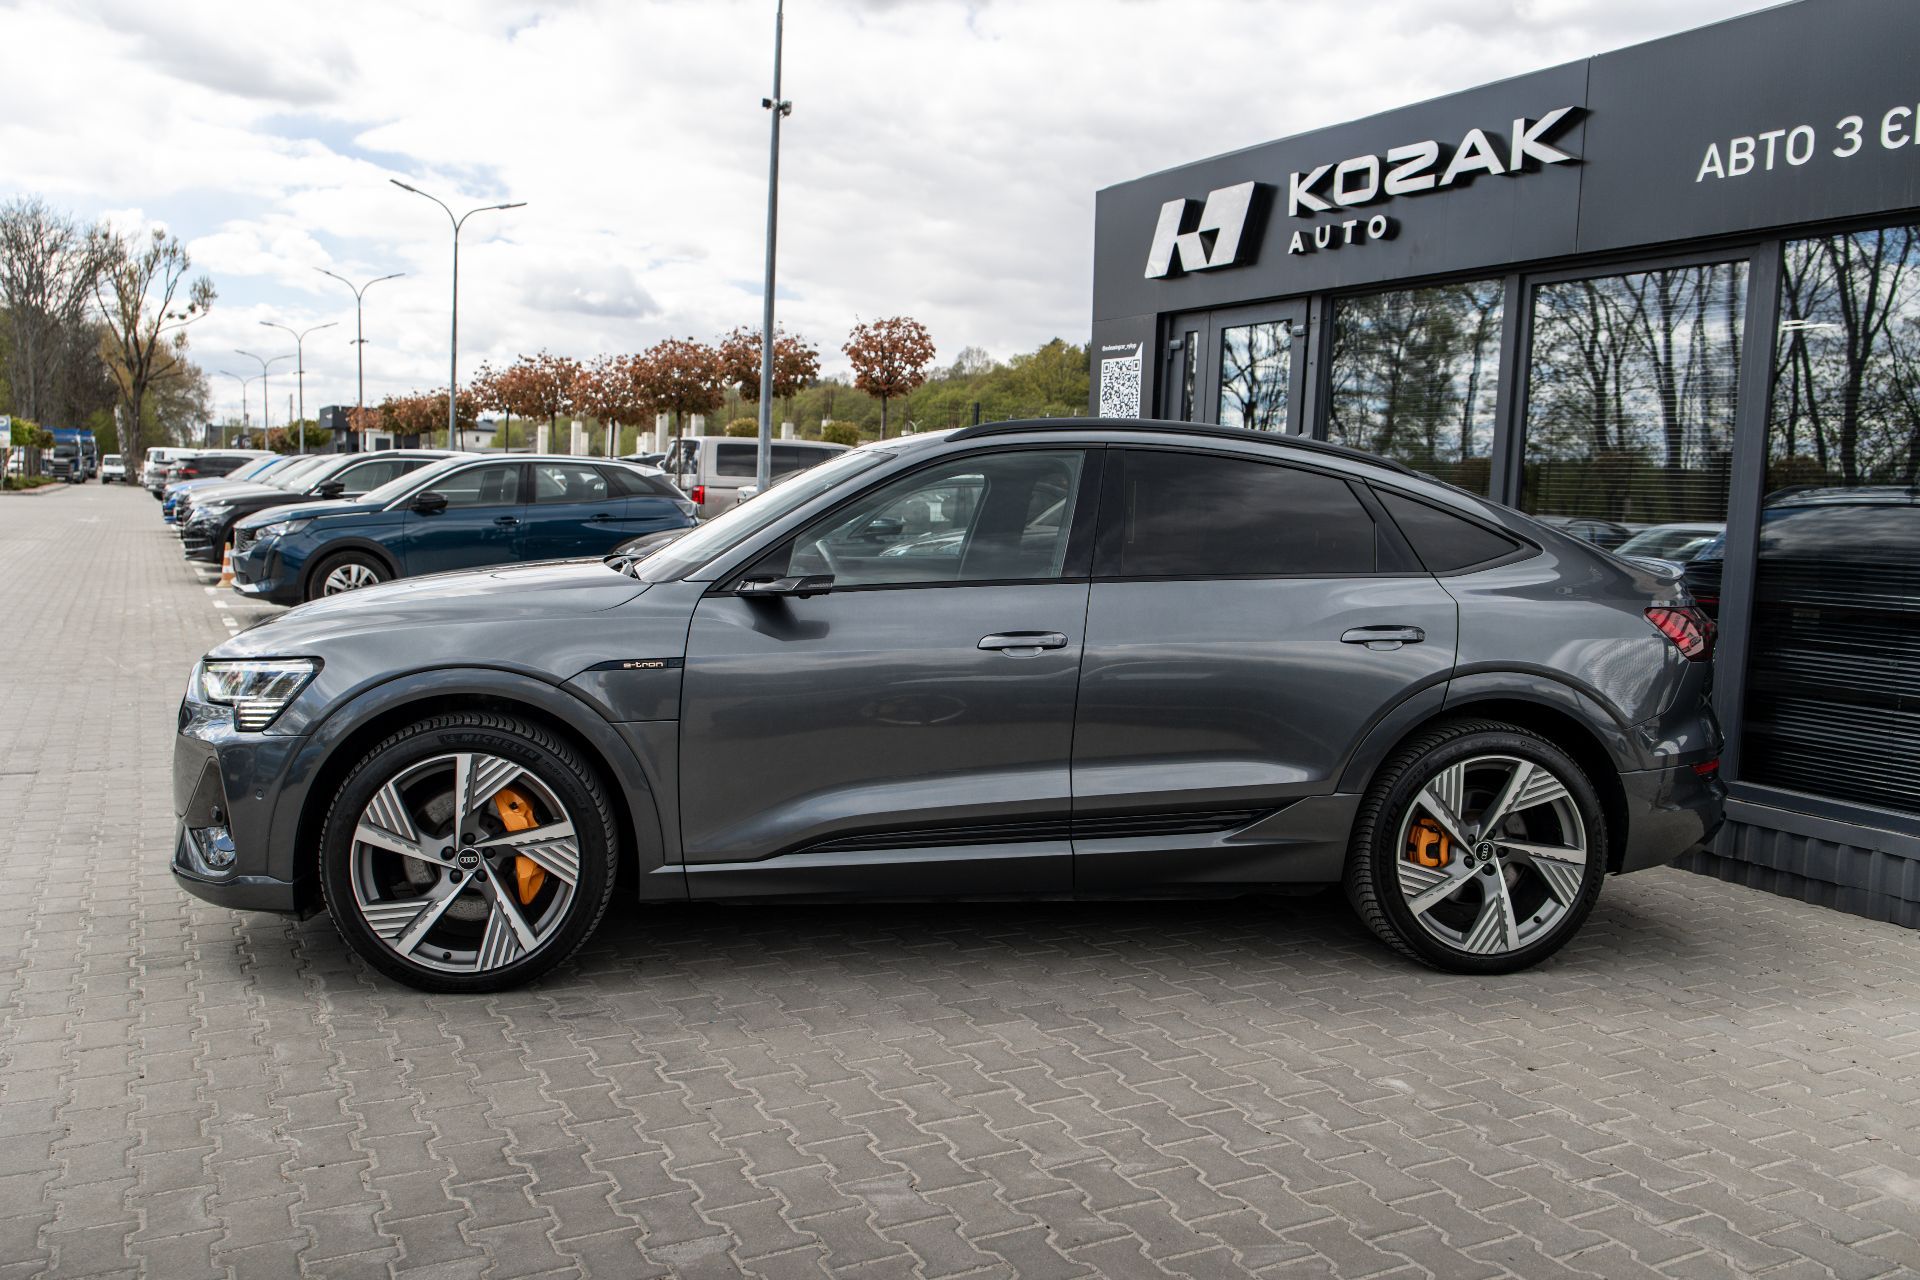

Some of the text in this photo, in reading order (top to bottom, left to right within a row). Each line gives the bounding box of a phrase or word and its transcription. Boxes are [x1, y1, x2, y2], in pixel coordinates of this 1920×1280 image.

[1288, 106, 1578, 217] KOZAK
[1695, 125, 1816, 183] АВТО
[1288, 214, 1387, 254] AUTO
